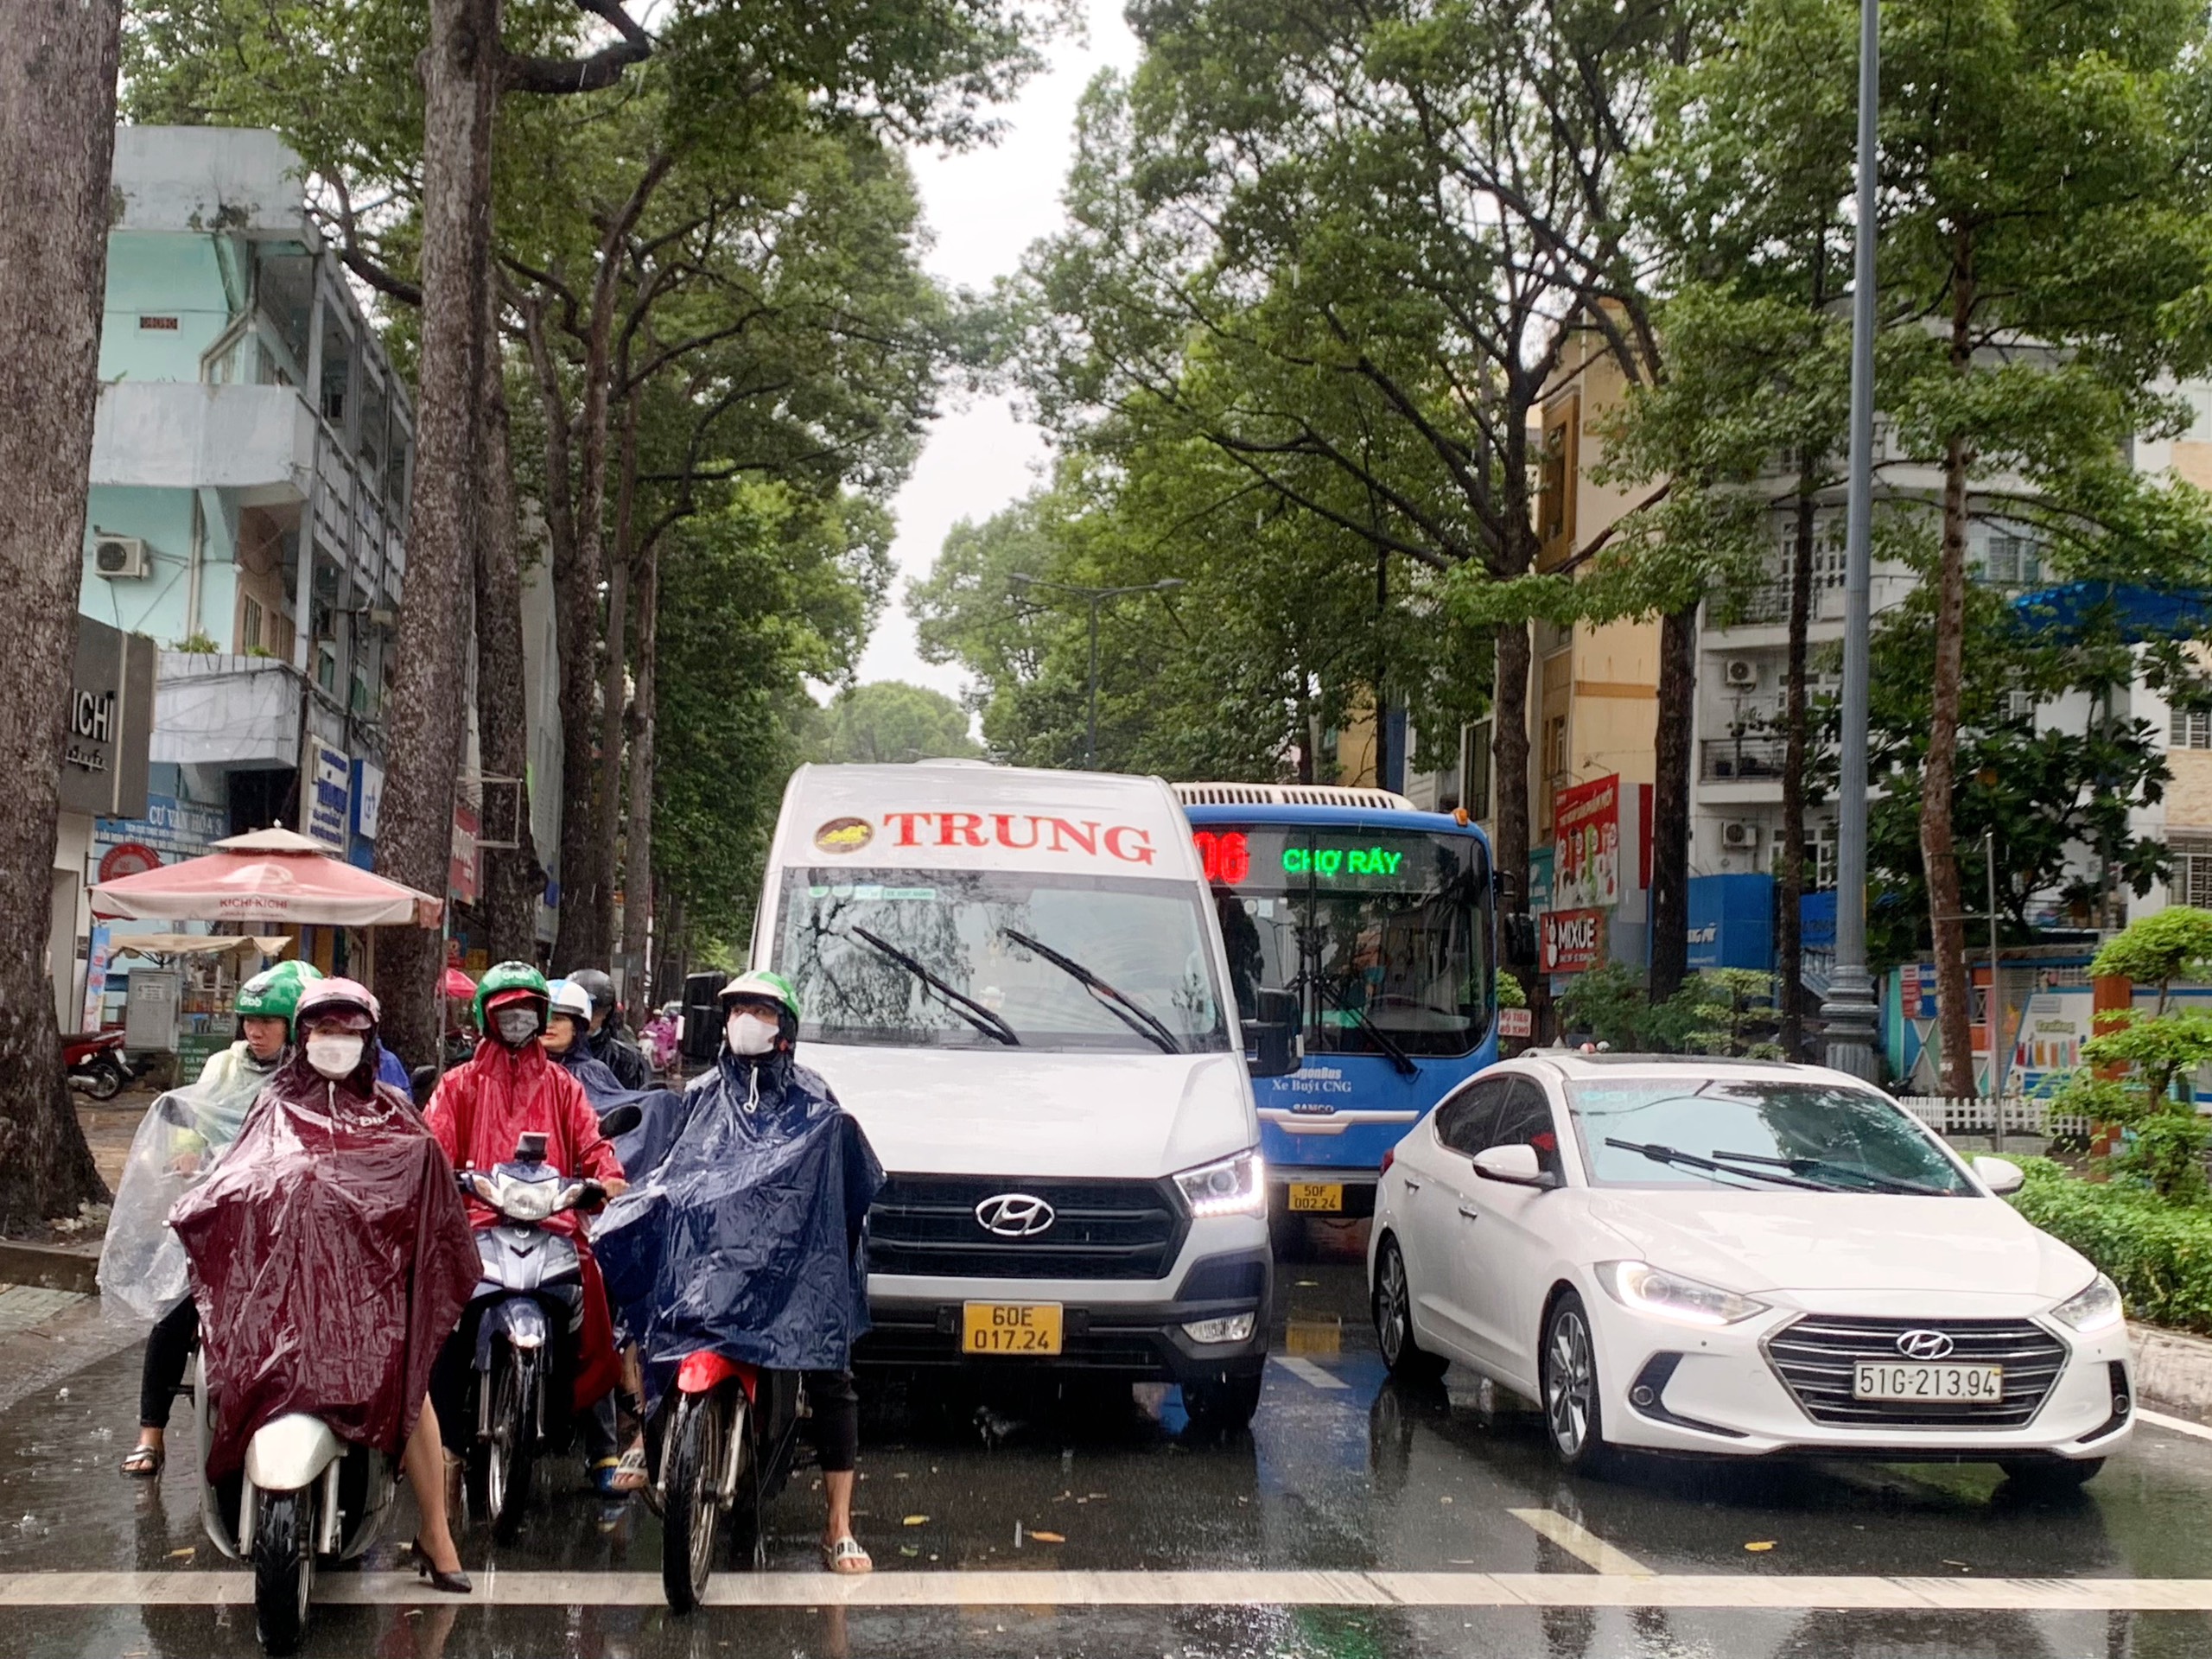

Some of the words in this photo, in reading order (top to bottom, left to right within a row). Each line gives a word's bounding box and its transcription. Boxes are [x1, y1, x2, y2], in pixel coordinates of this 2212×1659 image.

[884, 812, 1157, 865] TRUNG
[1282, 848, 1343, 877] CHỢ
[1348, 846, 1403, 875] RẪY
[219, 899, 289, 909] KICHI-KICHI
[1558, 918, 1595, 950] MIXUE
[1272, 1079, 1289, 1090] Xe
[1322, 1080, 1352, 1093] CNG
[1304, 1185, 1327, 1197] 50F
[993, 1306, 1033, 1326] 60E
[975, 1330, 1049, 1350] 017.24
[1860, 1367, 1995, 1396] 51G-213.94
